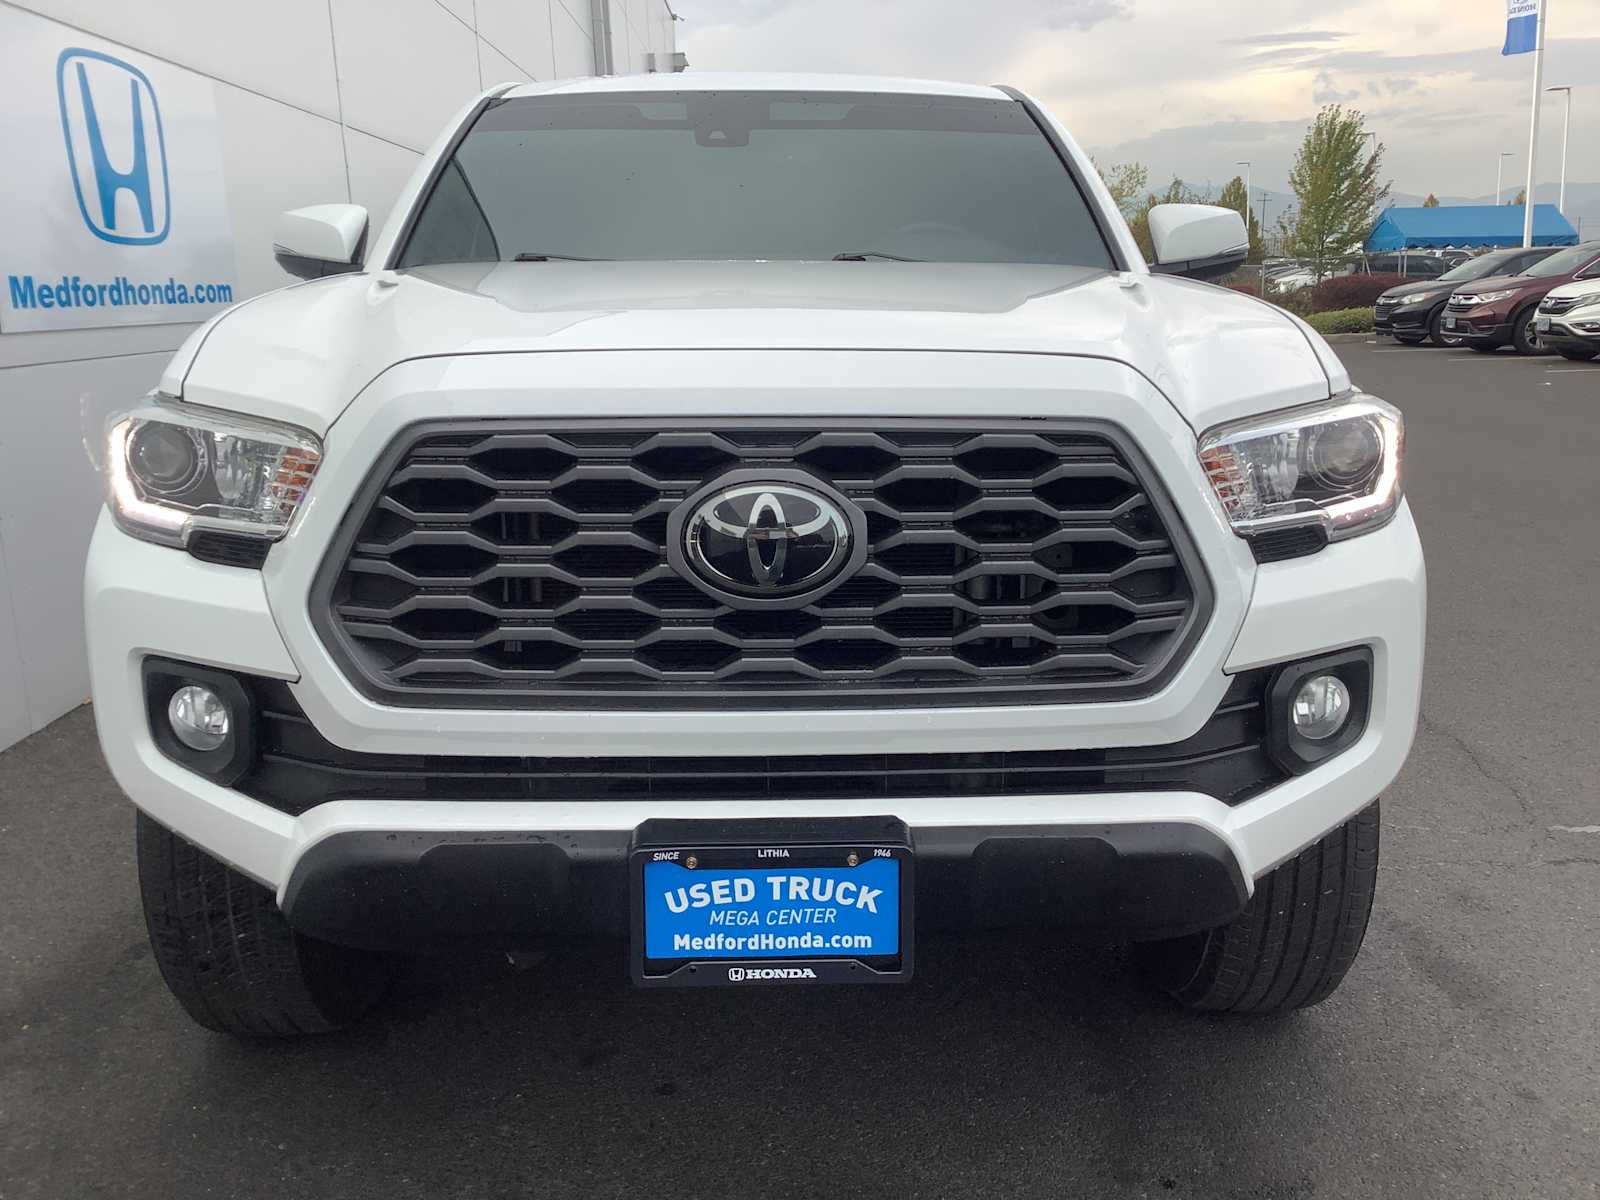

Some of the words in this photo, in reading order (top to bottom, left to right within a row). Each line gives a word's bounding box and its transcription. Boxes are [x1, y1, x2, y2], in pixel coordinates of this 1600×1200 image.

[8, 275, 233, 309] Medfordhonda.com
[653, 852, 680, 861] SINCE
[758, 849, 790, 858] LITHIA
[873, 849, 892, 858] 1946
[664, 878, 756, 913] USED
[766, 876, 883, 914] TRUCK
[709, 910, 760, 926] MEGA
[766, 908, 837, 925] CENTER
[673, 932, 872, 951] MedfordHonda.com
[746, 968, 817, 980] HONDA
